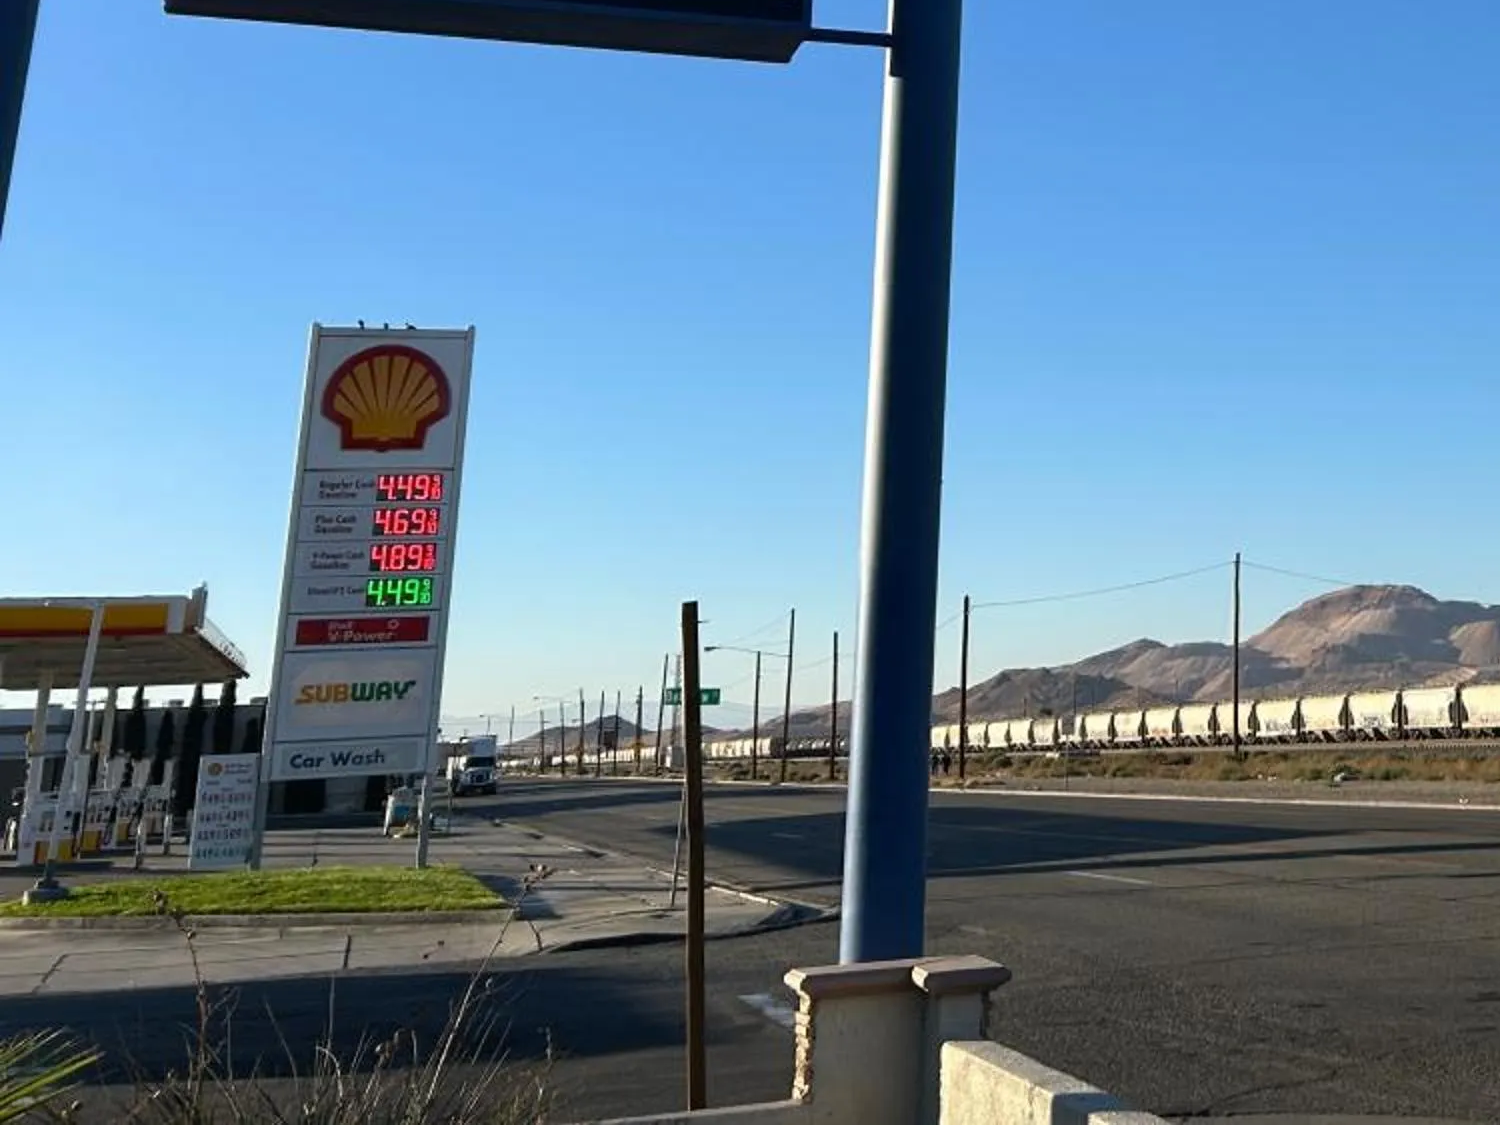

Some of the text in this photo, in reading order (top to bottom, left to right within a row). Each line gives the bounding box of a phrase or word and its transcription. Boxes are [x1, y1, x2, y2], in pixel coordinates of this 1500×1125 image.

[294, 680, 417, 705] SUBWAY
[289, 748, 385, 769] Car Wash
